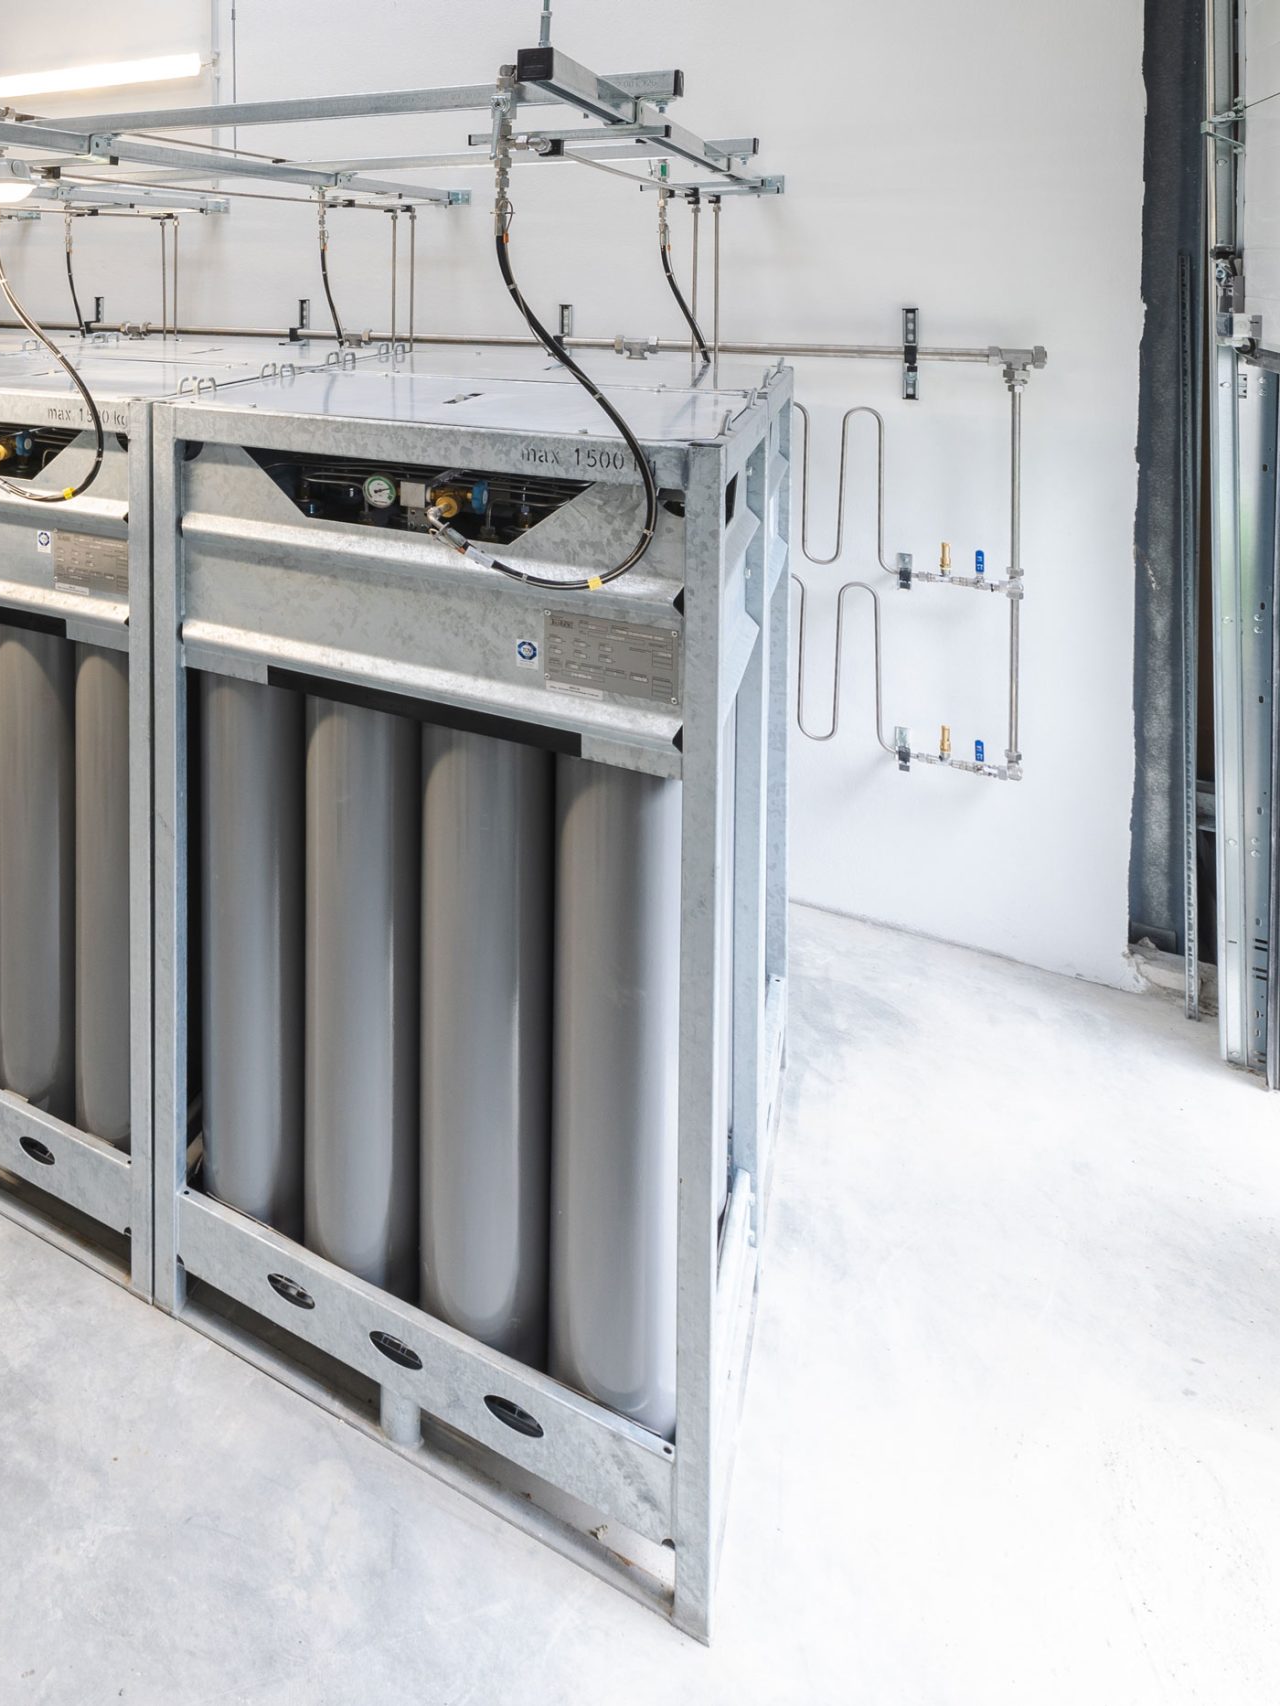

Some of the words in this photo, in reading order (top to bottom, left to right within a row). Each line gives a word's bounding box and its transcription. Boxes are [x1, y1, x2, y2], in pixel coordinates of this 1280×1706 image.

[47, 407, 71, 421] max
[79, 408, 110, 424] 150
[521, 448, 561, 465] max
[574, 447, 625, 470] 1500
